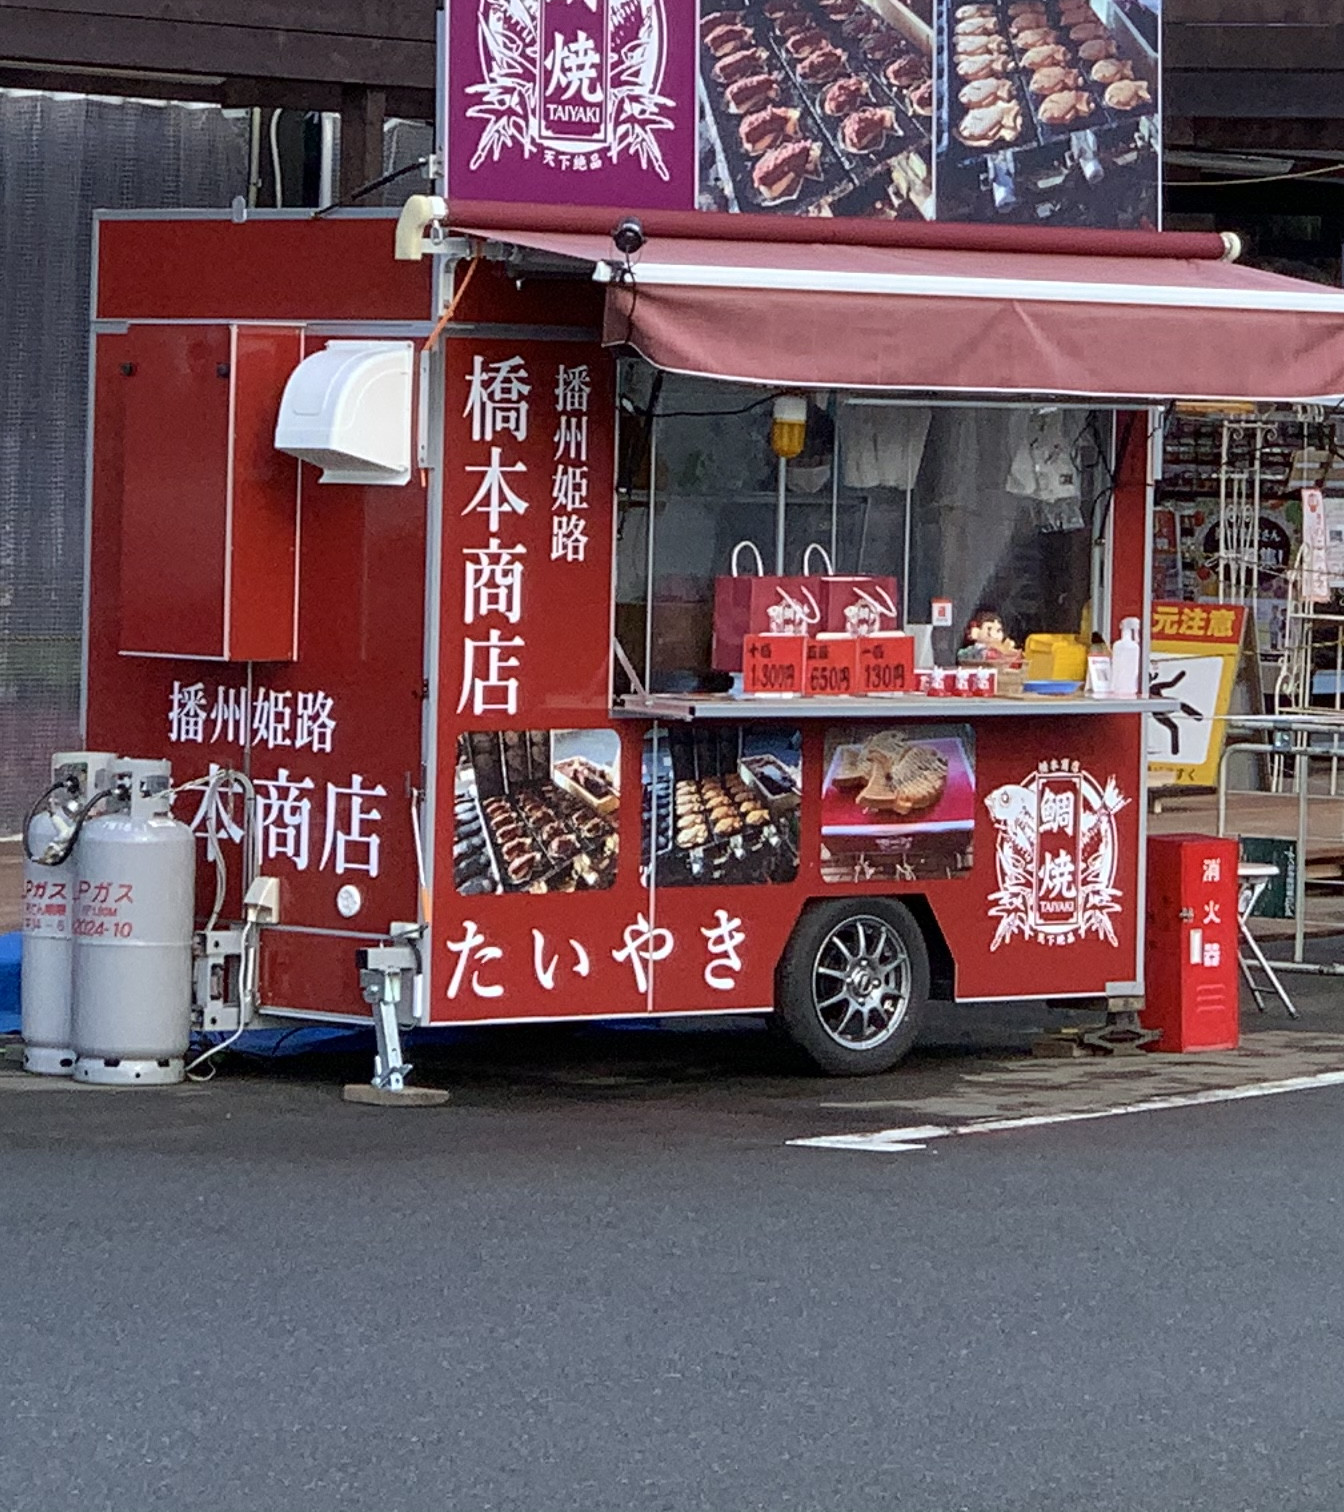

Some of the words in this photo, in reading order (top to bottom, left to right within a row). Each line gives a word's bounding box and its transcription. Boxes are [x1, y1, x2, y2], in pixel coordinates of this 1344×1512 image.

[542, 148, 603, 172] 天下絶品
[546, 103, 600, 124] TAIYAKI
[549, 364, 591, 563] 播州姫路
[456, 354, 531, 717] 橋本商店
[167, 679, 337, 753] 播州姫路
[170, 763, 387, 878] 本商店
[1038, 787, 1077, 899] 鯛焼
[445, 910, 747, 1000] たいやき
[1202, 857, 1221, 968] 消火器
